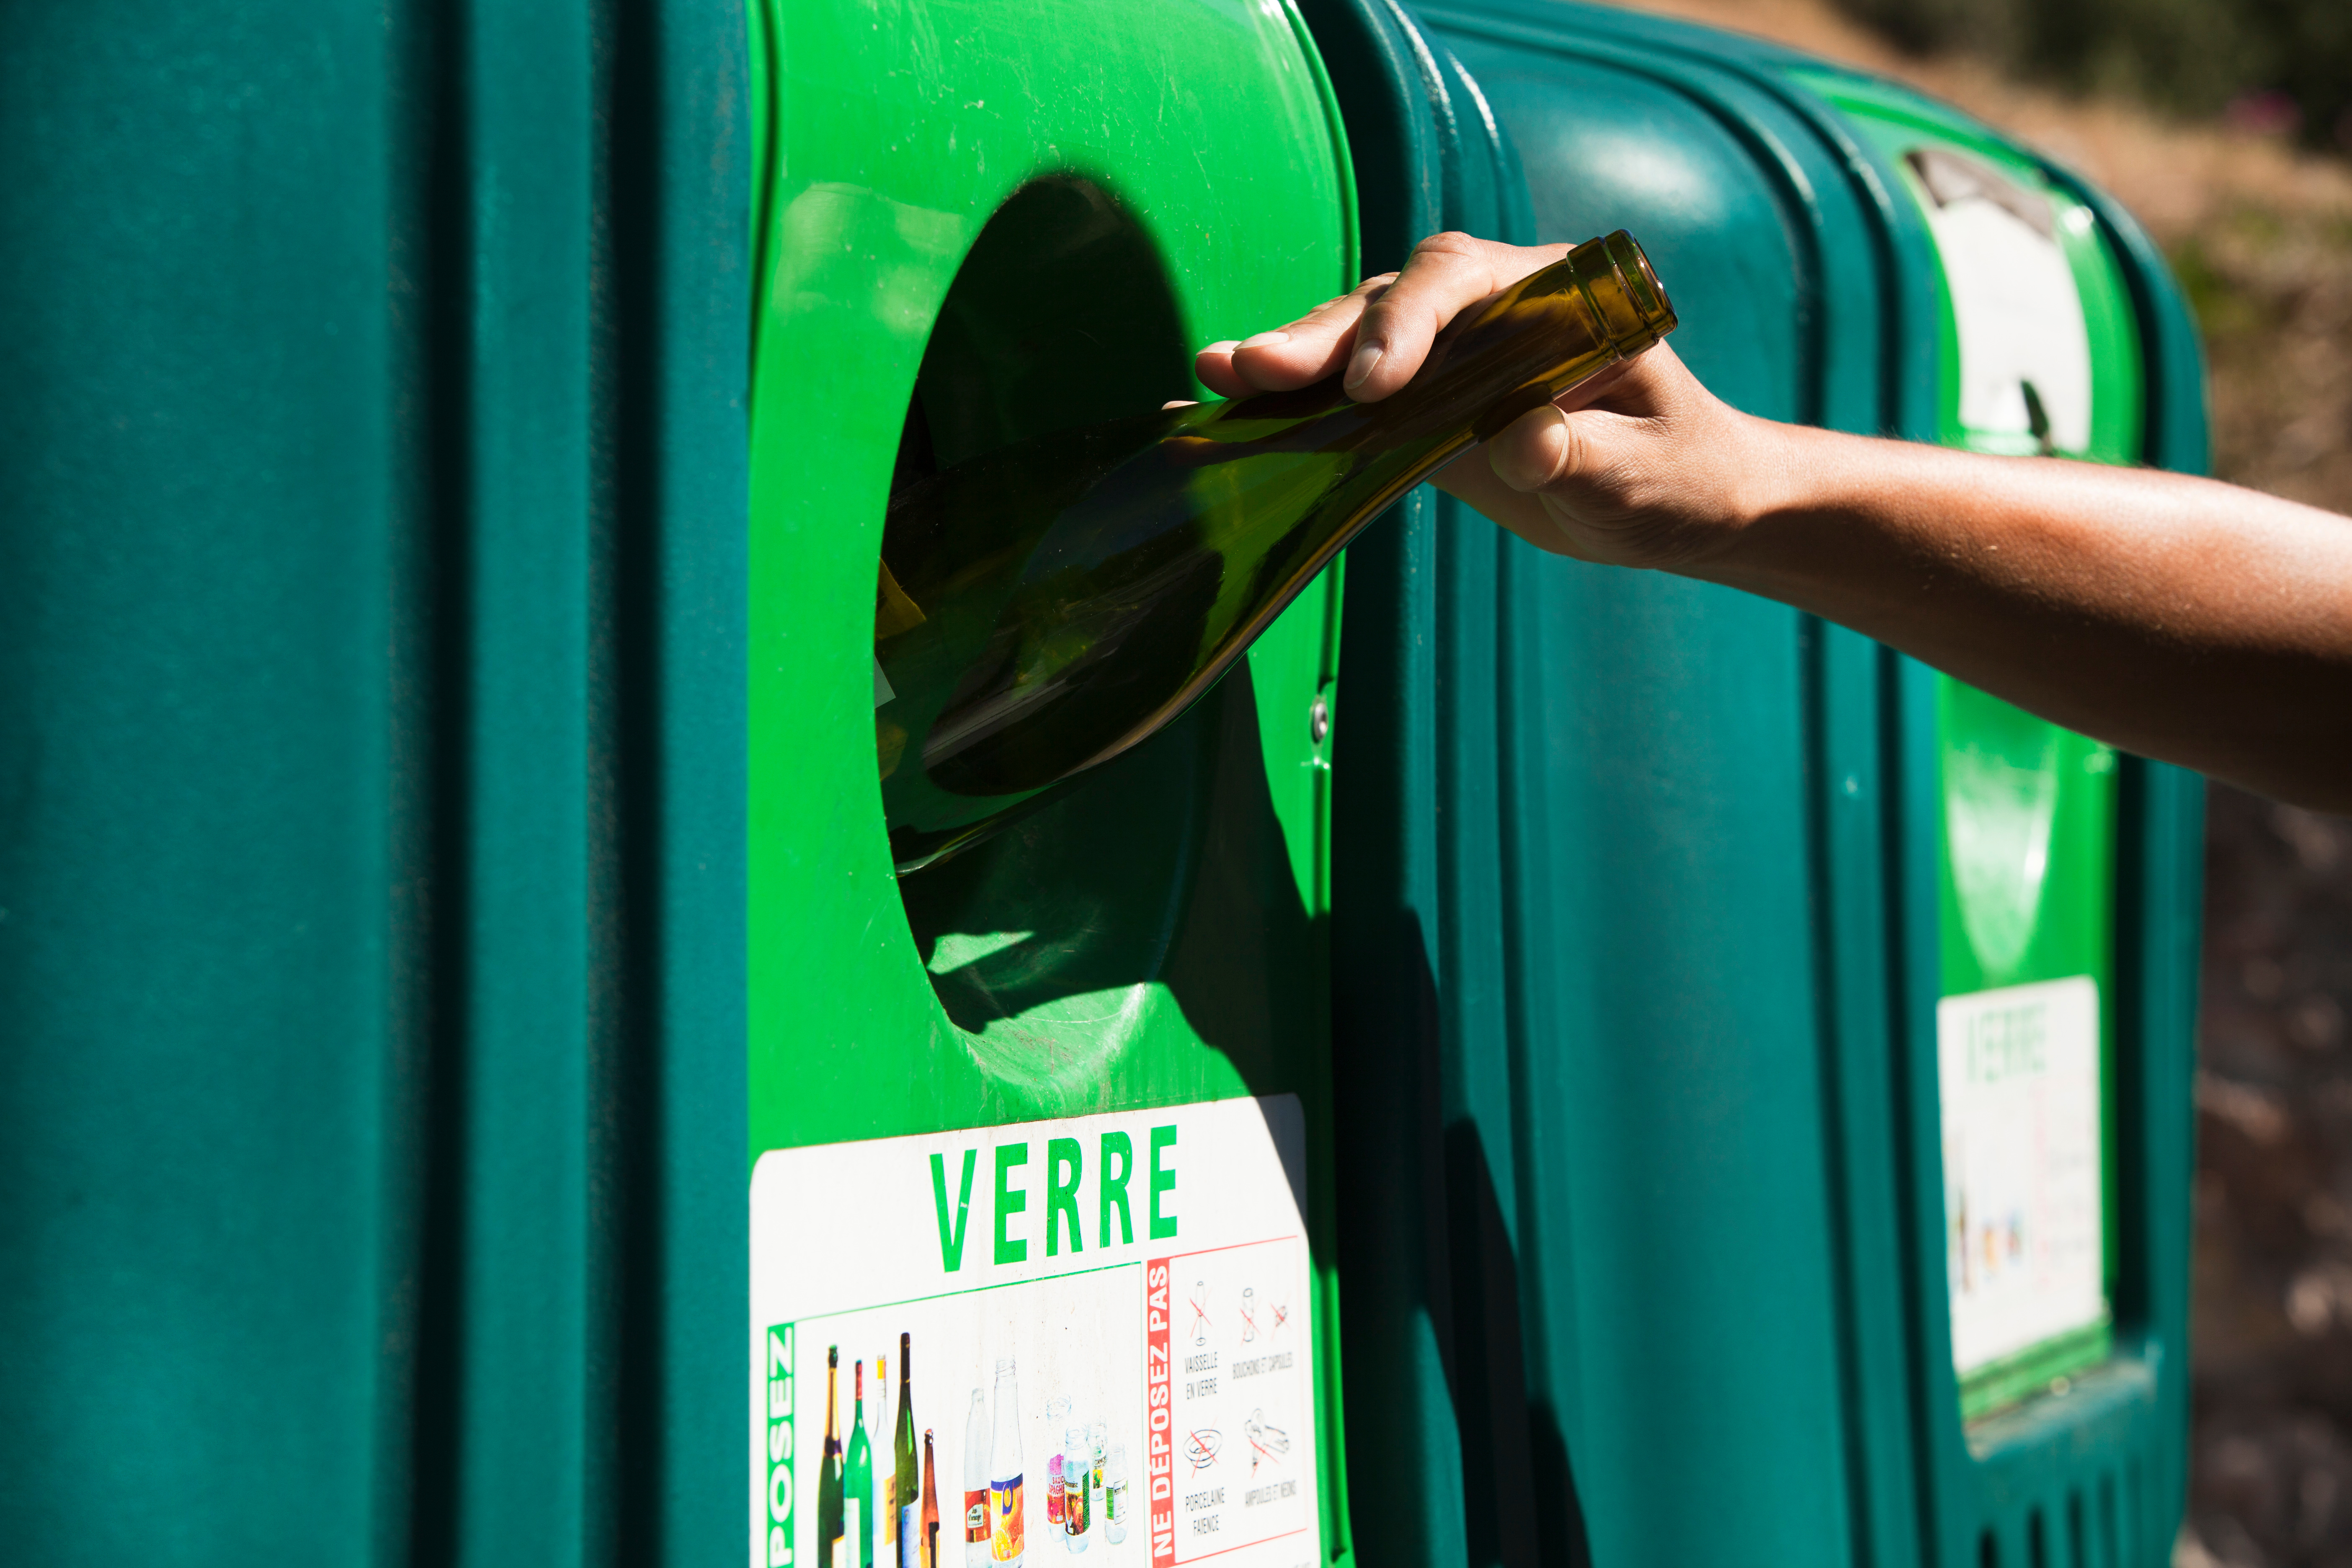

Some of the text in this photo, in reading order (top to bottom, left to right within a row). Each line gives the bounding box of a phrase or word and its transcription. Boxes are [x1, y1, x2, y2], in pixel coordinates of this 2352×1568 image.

[929, 1124, 1177, 1273] VERRE
[1149, 1266, 1168, 1332] PAS
[1185, 1351, 1217, 1373] VAISSELLE
[1233, 1359, 1259, 1379] BOUCHONS
[1261, 1357, 1266, 1373] ET
[1186, 1377, 1217, 1399] EN VERRE
[1052, 1475, 1065, 1484] SAUC
[1186, 1487, 1225, 1512] PORCELAINE
[1273, 1484, 1278, 1500] ET
[1153, 1511, 1172, 1558] NE
